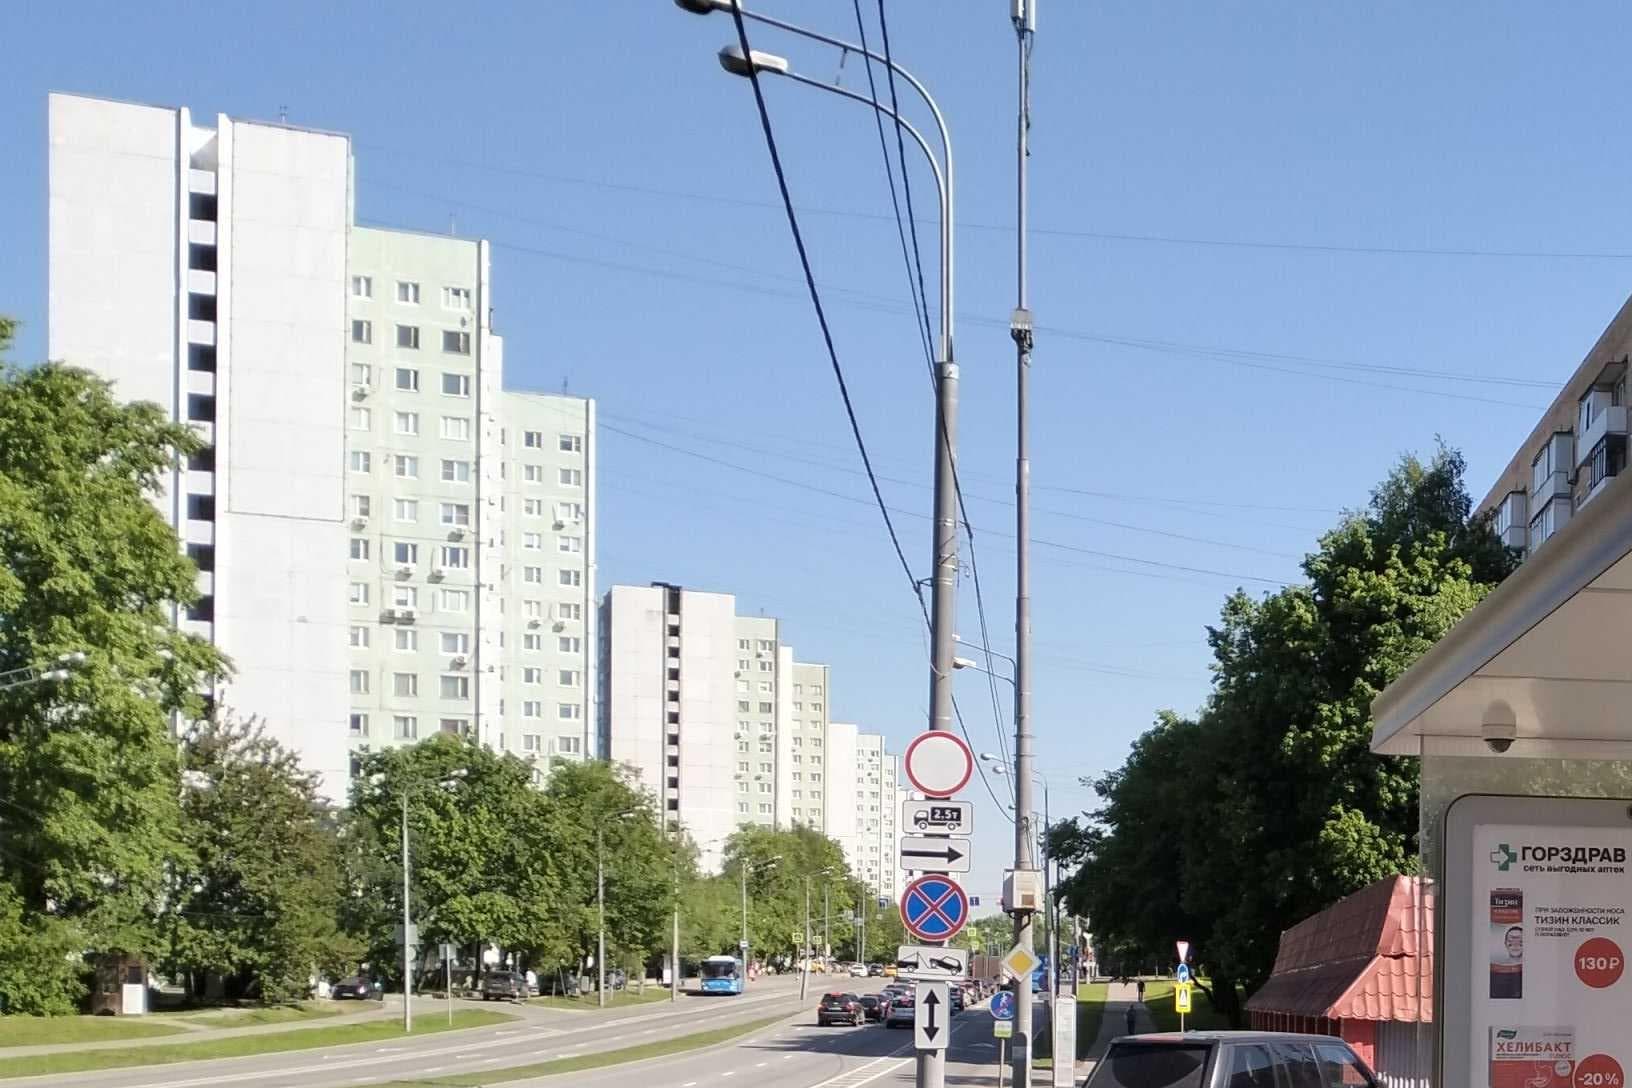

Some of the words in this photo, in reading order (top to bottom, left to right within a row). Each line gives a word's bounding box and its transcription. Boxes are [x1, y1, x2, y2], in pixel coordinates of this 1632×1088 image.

[1521, 846, 1626, 865] ГОРЗДРАВ
[1523, 864, 1545, 872] сеть
[1546, 865, 1596, 874] выгодных
[1597, 865, 1625, 873] аптек
[1534, 915, 1570, 925] ТИЗИН
[1571, 915, 1620, 925] КЛАССИК
[1496, 1041, 1572, 1053] ХЕЛИБАКТ
